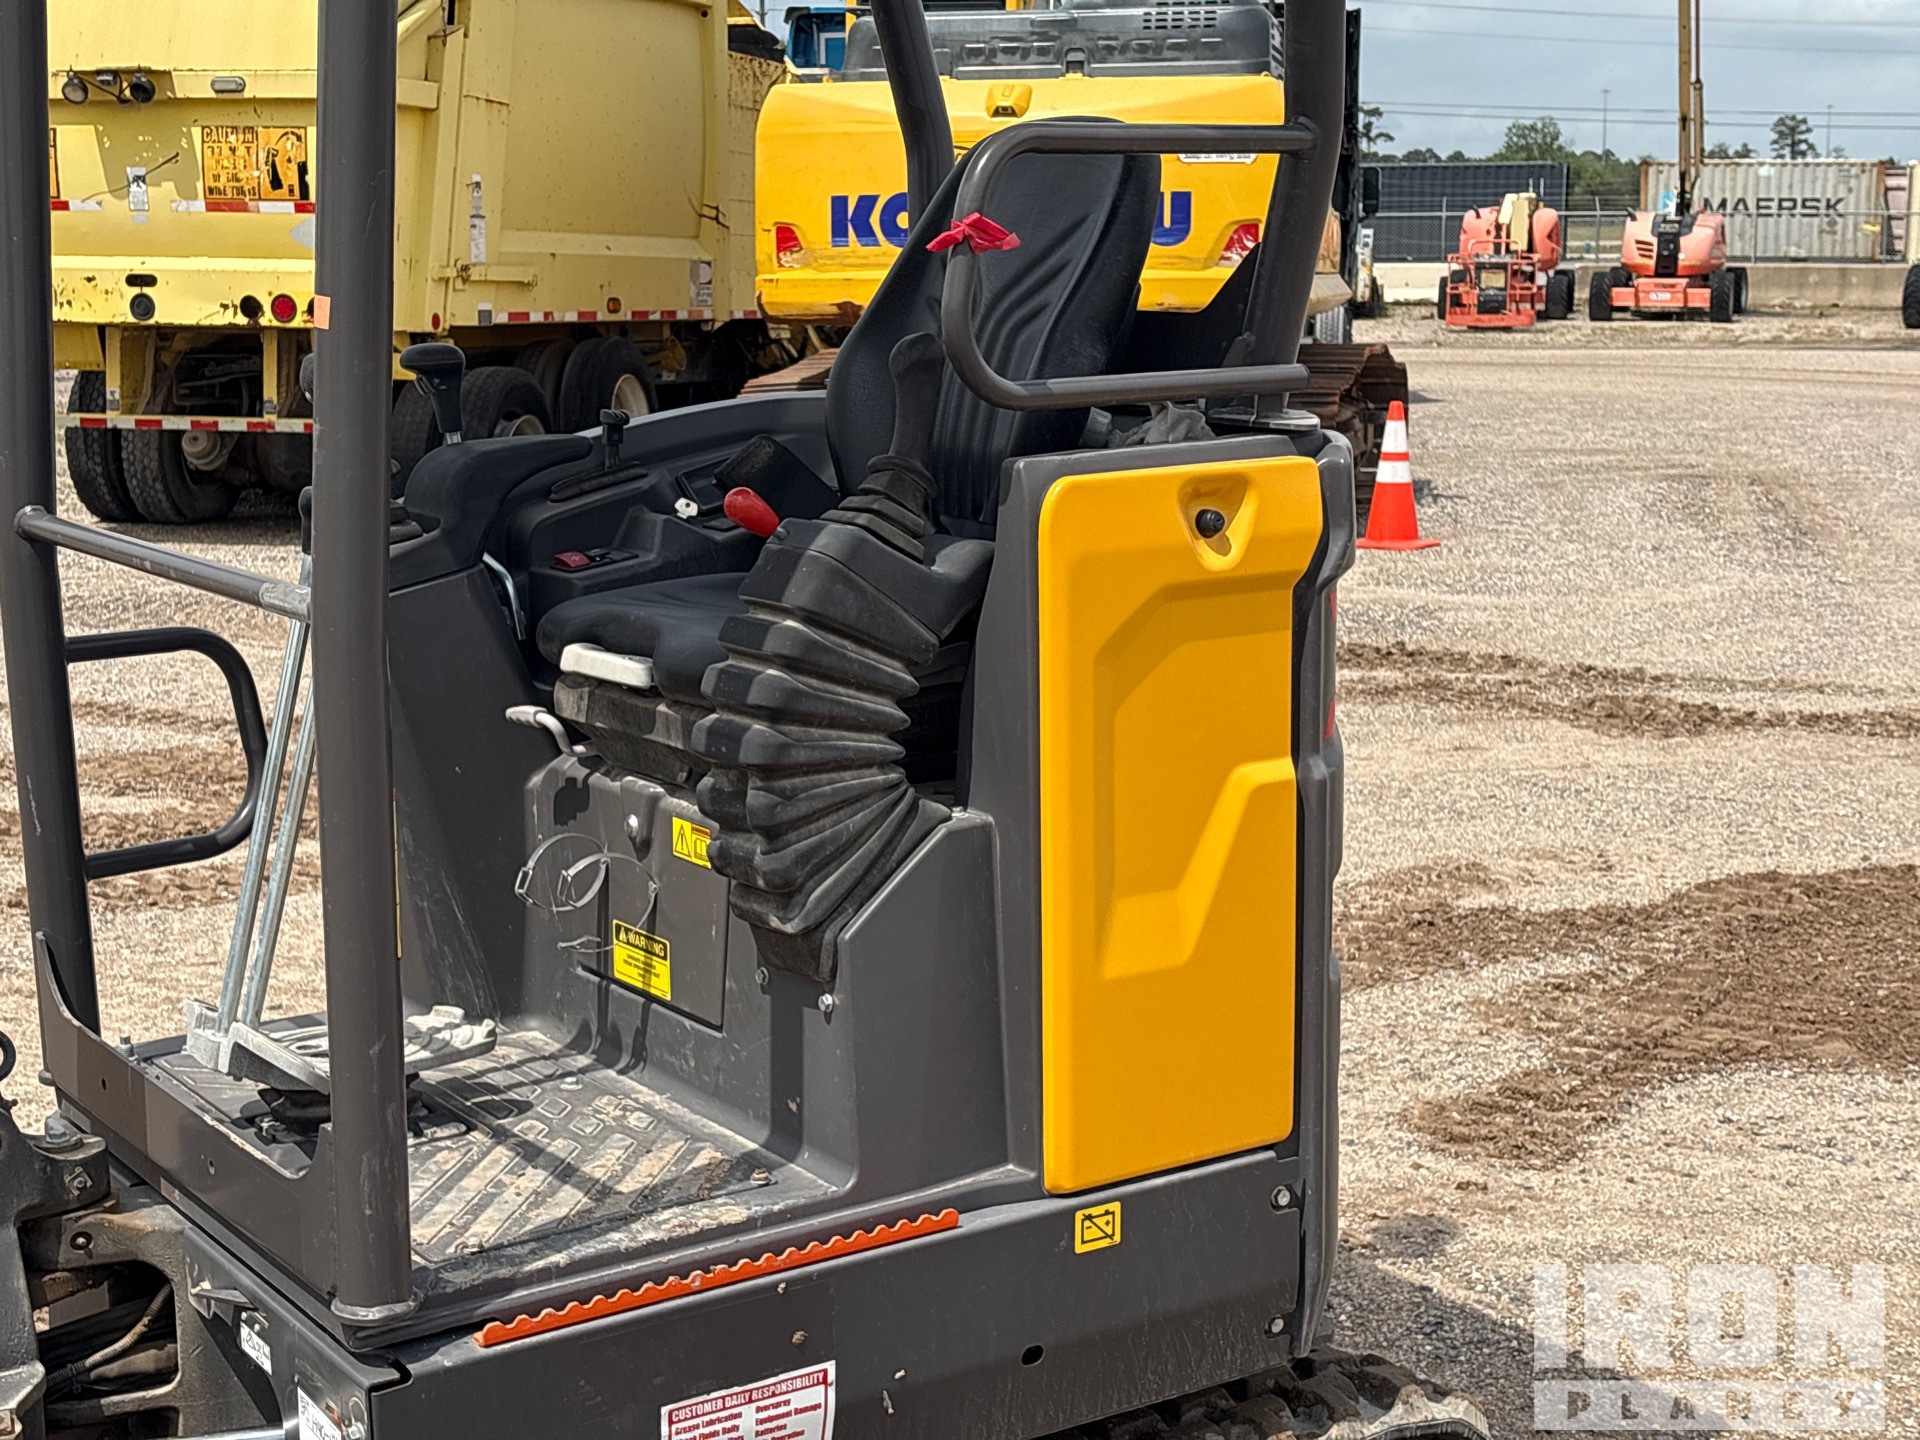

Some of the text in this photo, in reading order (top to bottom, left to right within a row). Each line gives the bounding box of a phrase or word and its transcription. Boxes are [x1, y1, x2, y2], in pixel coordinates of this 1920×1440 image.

[1703, 197, 1845, 217] MAERSK
[627, 931, 665, 957] WARNING
[672, 1371, 824, 1422] CUSTOMER DAILY RESPONSIBILITY
[755, 1398, 791, 1414] Overspray
[674, 1411, 743, 1436] Grease Lubrication
[755, 1402, 822, 1427] Equipment Damage
[721, 1424, 740, 1436] Daily
[754, 1423, 788, 1438] Batteries
